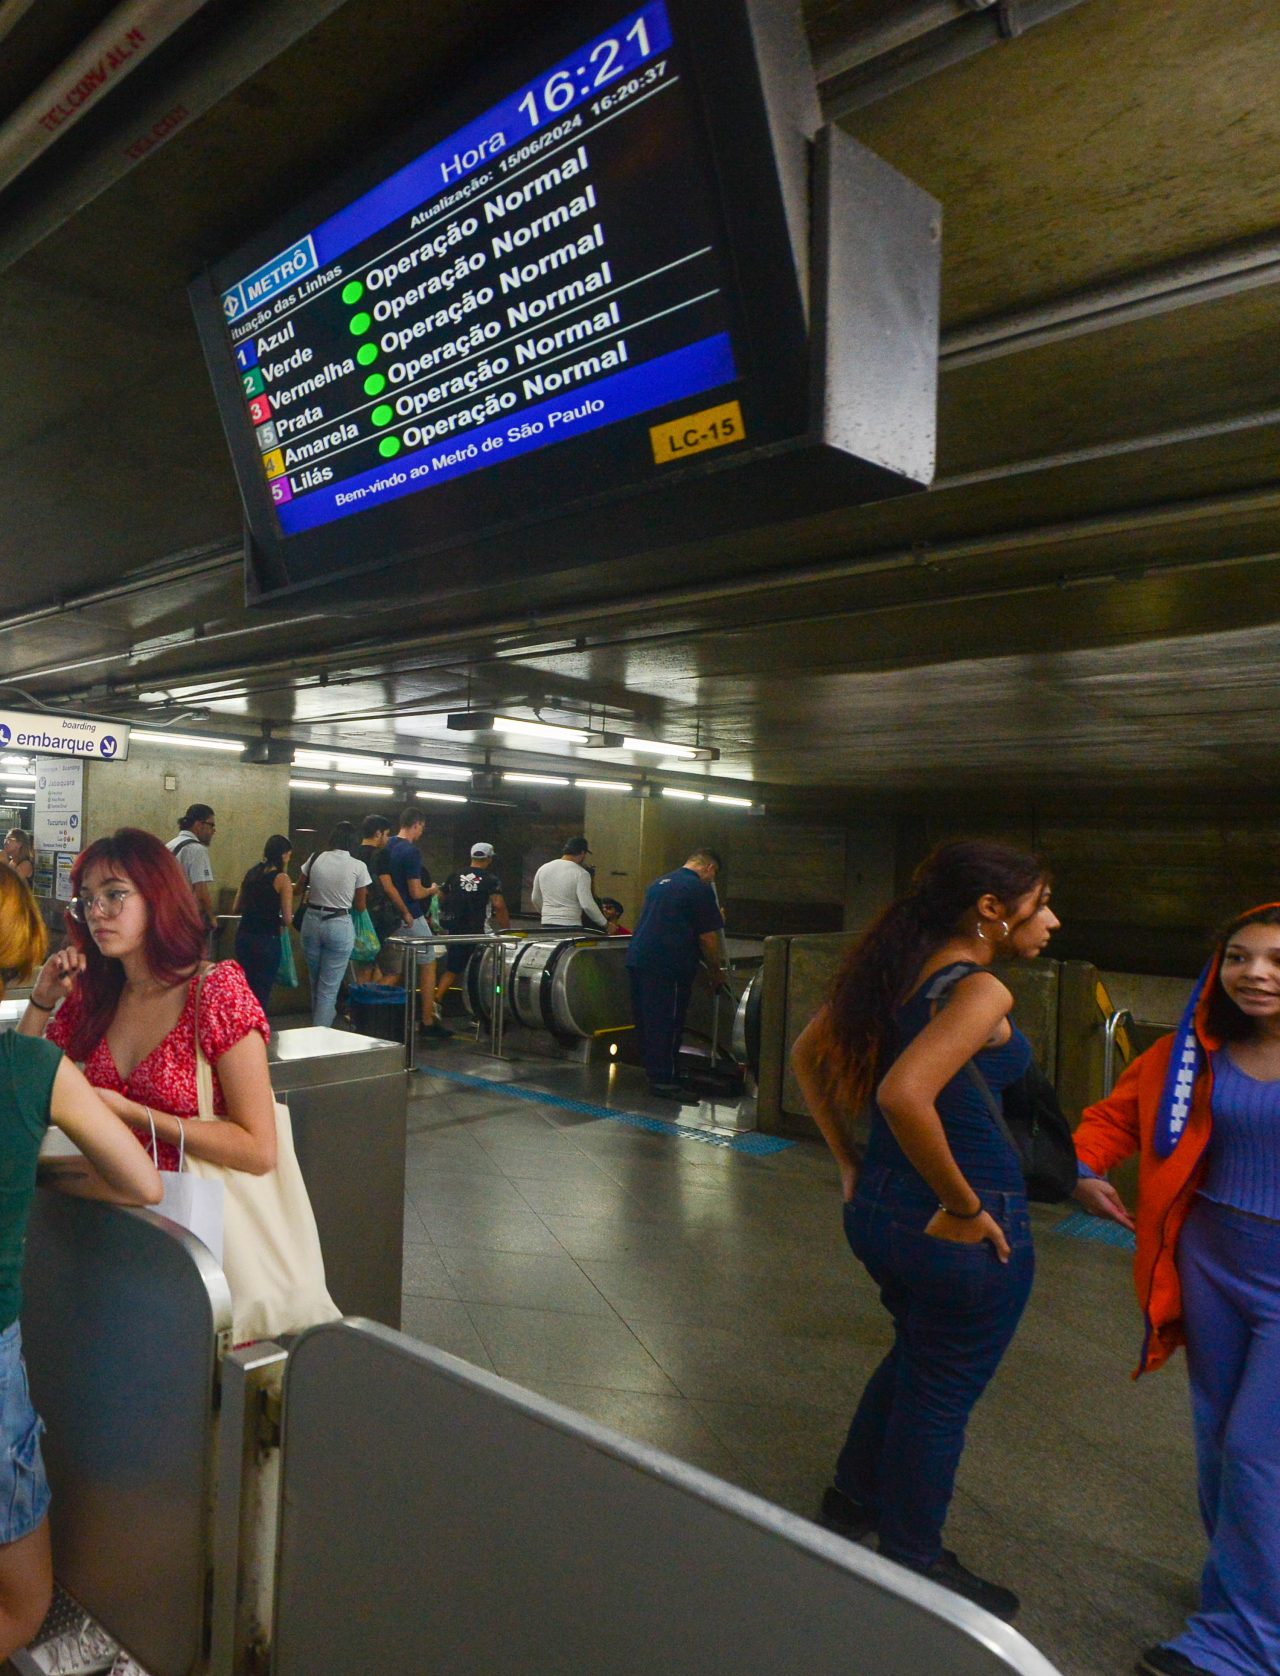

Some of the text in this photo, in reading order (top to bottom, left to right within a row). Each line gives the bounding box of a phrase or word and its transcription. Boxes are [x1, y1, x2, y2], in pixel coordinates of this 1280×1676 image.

[410, 60, 668, 229] Atualização: 15/06/2024 16:20:37
[440, 16, 651, 183] Hora 16:21
[237, 145, 589, 366] 1 Azul Operação Normal
[243, 184, 597, 394] 2 Verde Operação Normal
[247, 250, 308, 301] METRÔ
[250, 223, 605, 420] 3 Vermelha Operação Normal
[274, 294, 297, 316] das
[297, 264, 343, 300] Linhas
[265, 301, 621, 472] 4 Amarela Operação Normal
[271, 340, 628, 500] 5 Lilás Operação Normal
[276, 405, 323, 438] Prata
[388, 320, 501, 384] Operação
[506, 261, 613, 329] Normal
[335, 397, 605, 507] Bem-vindo ao Metrô de São Paulo
[668, 418, 736, 453] LC-15
[16, 732, 95, 754] embarque
[62, 720, 97, 734] boarding
